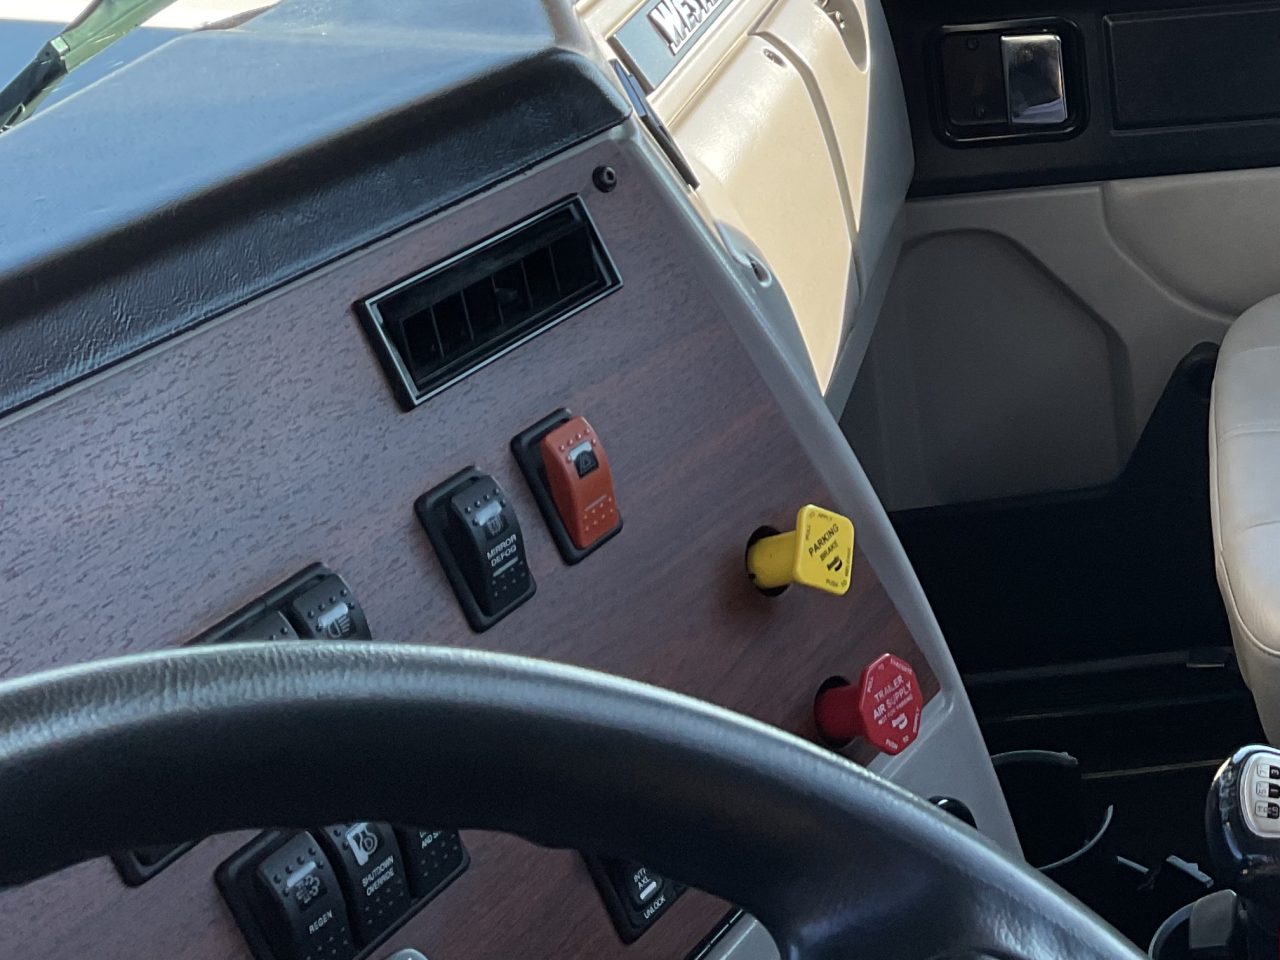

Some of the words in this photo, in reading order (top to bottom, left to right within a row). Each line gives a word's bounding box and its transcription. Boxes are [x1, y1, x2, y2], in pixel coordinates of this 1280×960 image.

[487, 534, 517, 560] MIRROR
[808, 523, 839, 558] PARKING
[819, 540, 839, 561] BRAKE
[491, 544, 517, 567] DEFOG
[873, 703, 887, 720] AIR
[886, 680, 912, 709] SUPPLY
[874, 674, 904, 703] TRAILER
[362, 855, 394, 887] SHUTDOWN
[366, 867, 395, 897] OVERRIDE
[643, 894, 666, 919] UNLOCK
[308, 909, 333, 935] REGEN
